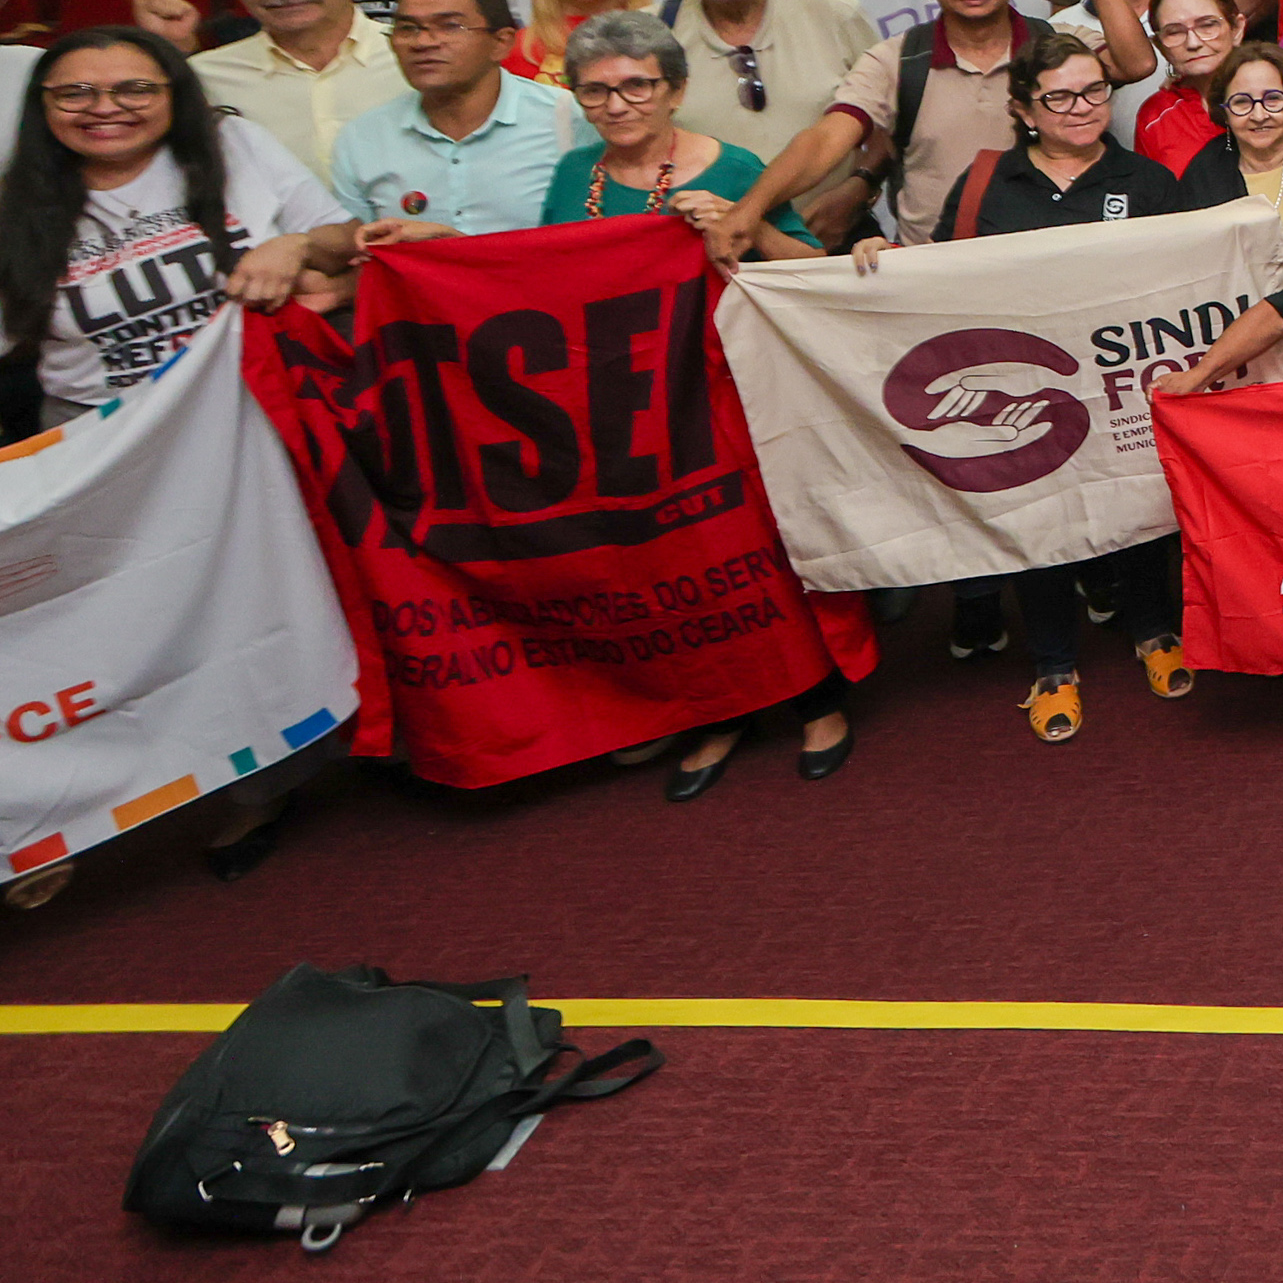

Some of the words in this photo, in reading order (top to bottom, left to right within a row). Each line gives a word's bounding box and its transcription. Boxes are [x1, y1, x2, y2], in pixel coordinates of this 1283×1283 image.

[64, 227, 251, 335] LUT
[1109, 412, 1151, 429] SINDIC
[1116, 438, 1156, 454] MUNIC
[653, 575, 701, 611] DO
[703, 539, 788, 598] SERV
[630, 629, 676, 662] DO
[679, 588, 787, 649] CEARÁ
